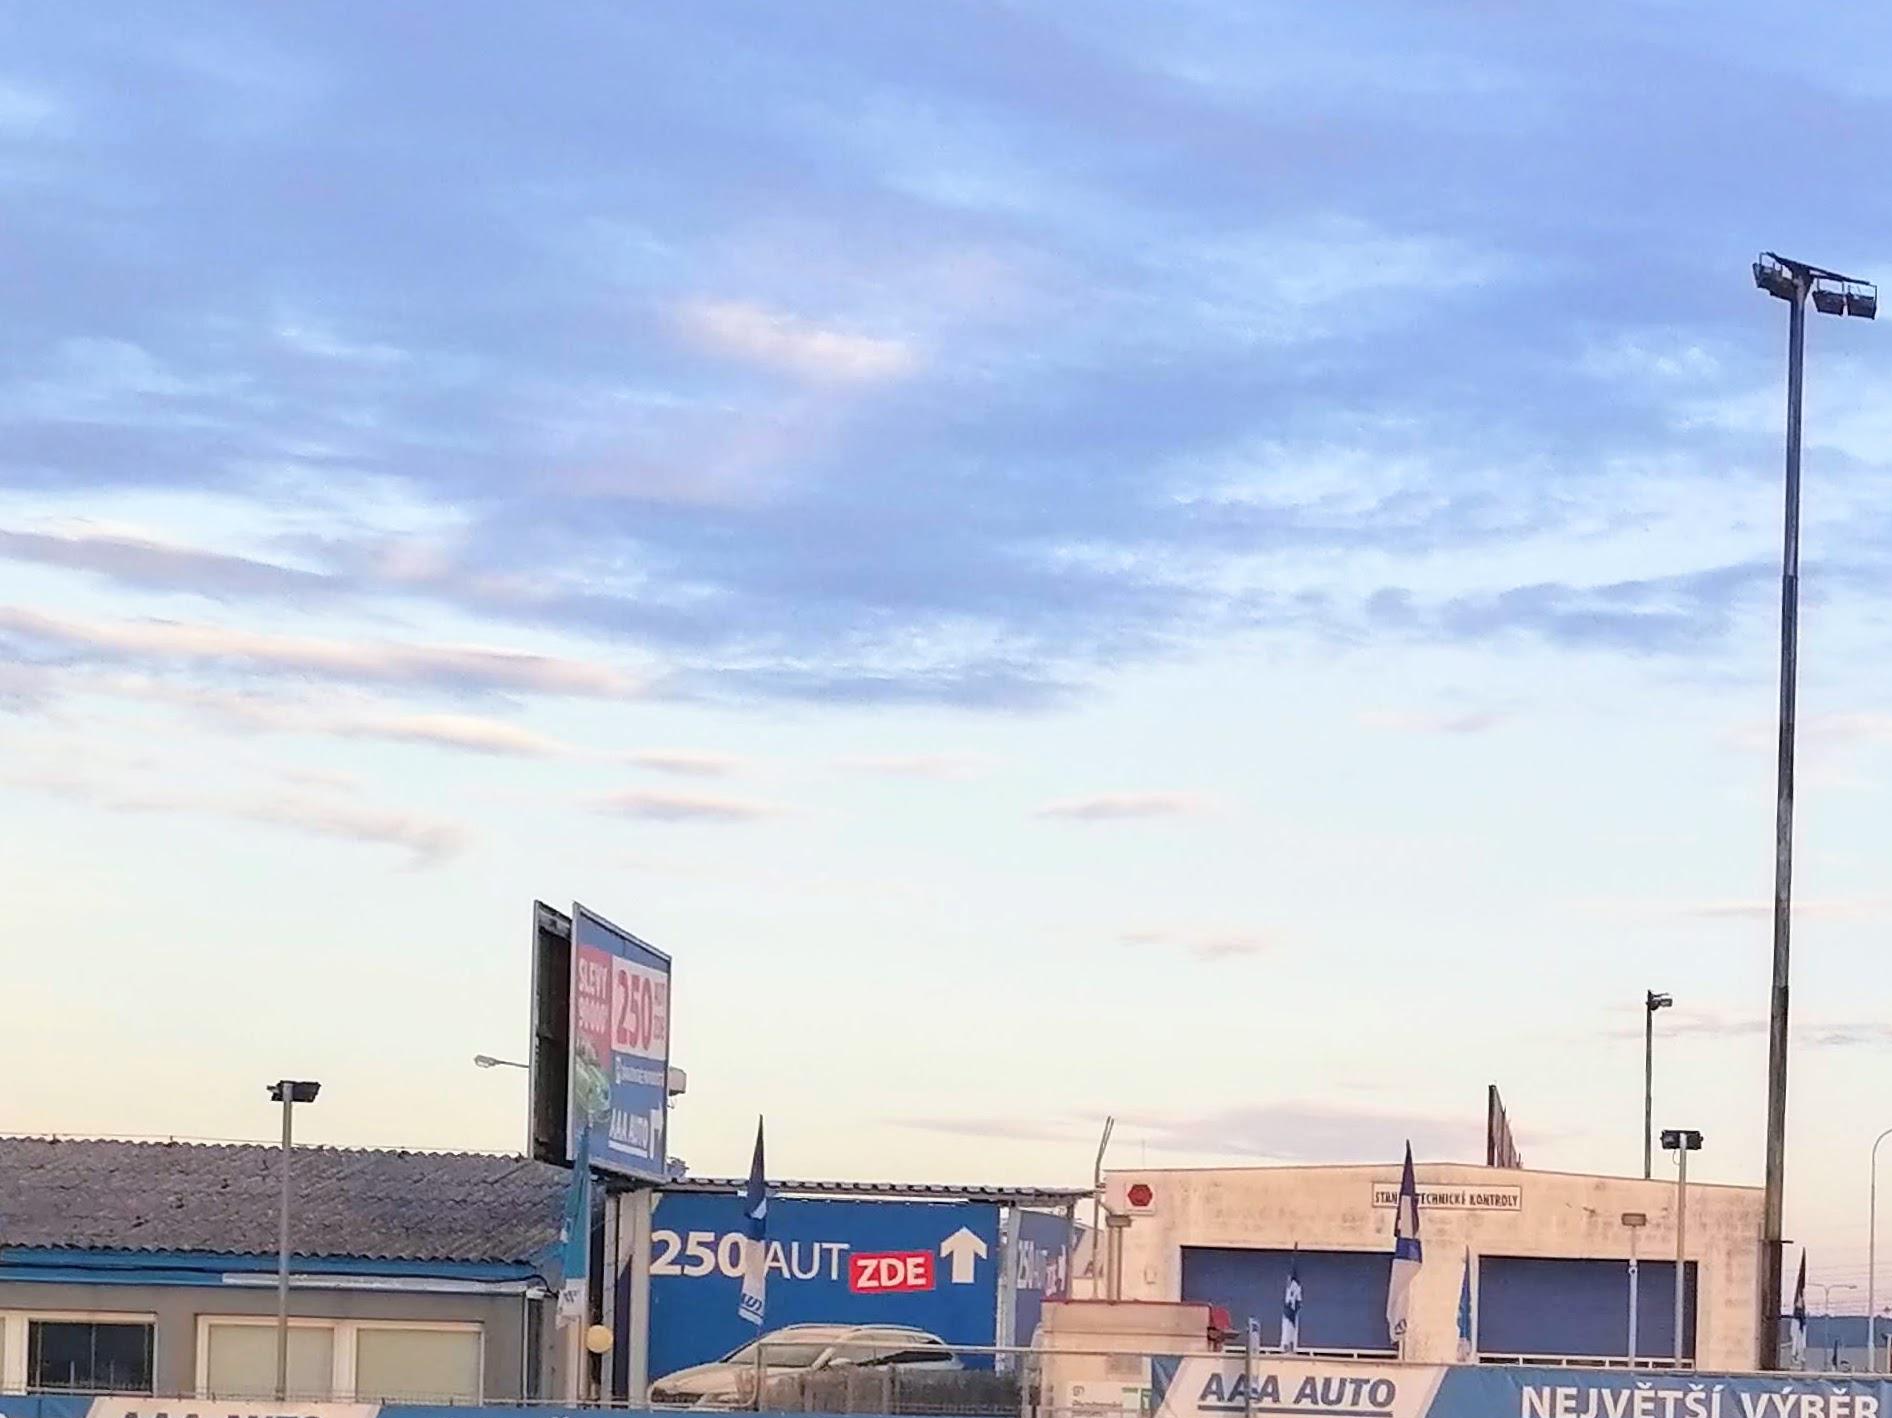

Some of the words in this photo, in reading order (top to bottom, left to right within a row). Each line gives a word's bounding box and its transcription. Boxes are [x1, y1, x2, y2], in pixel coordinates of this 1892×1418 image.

[617, 969, 653, 1051] 250
[1469, 1195, 1518, 1207] KONTROLY
[649, 1231, 747, 1278] 250
[763, 1240, 850, 1281] AUT
[856, 1256, 928, 1289] ZDE
[1200, 1373, 1280, 1403] AAA
[1293, 1376, 1396, 1408] AUTO
